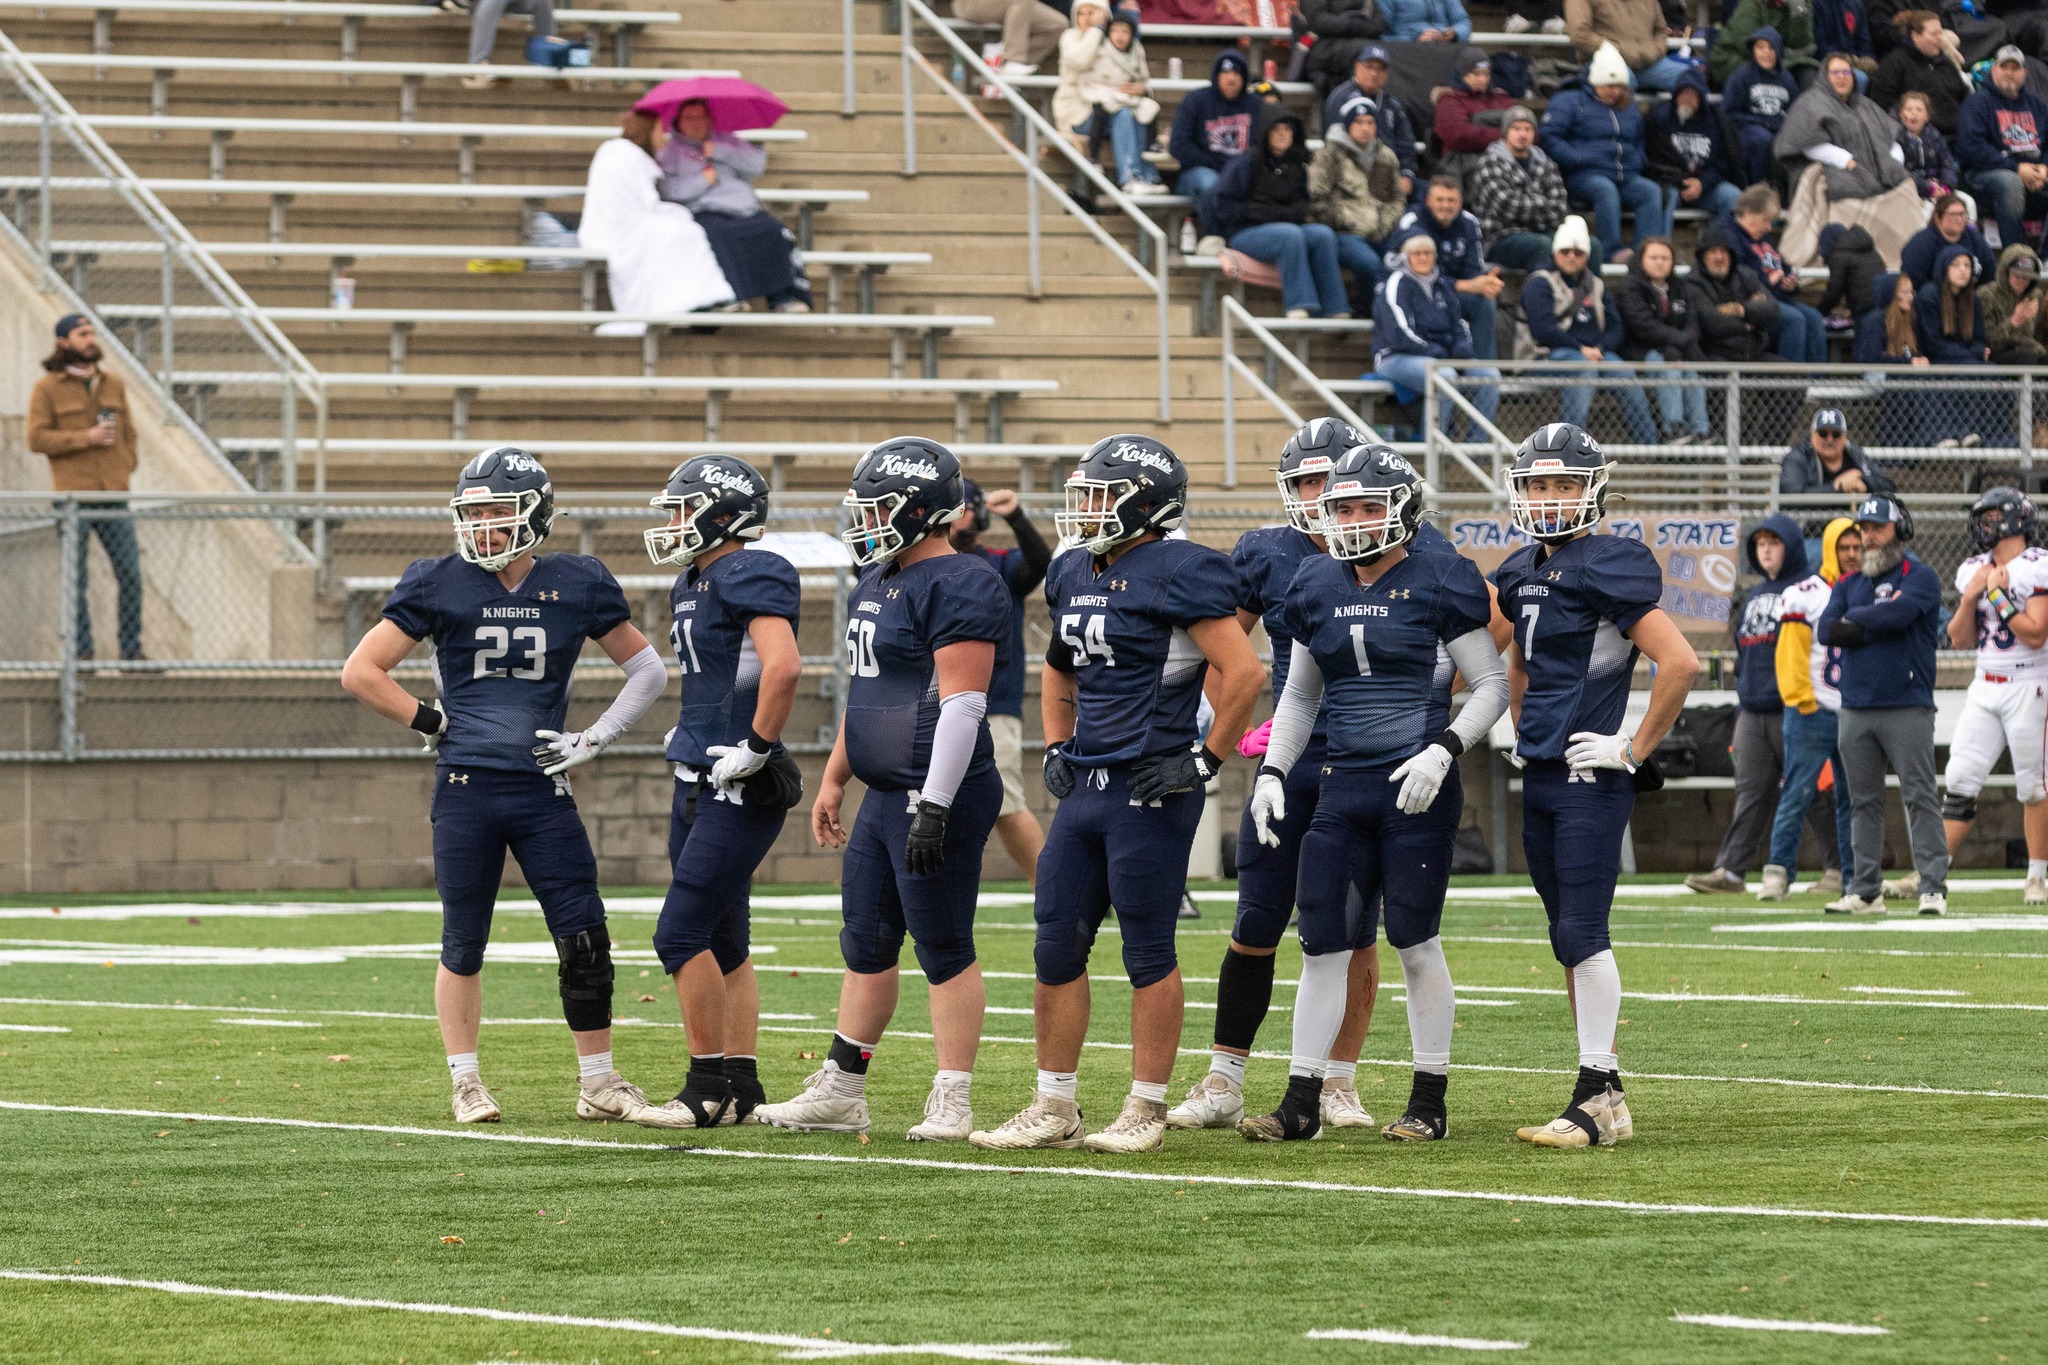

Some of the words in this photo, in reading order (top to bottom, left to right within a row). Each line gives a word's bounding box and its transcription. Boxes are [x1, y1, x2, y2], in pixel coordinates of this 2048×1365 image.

[504, 454, 548, 474] Knig
[875, 454, 940, 481] Knights
[1111, 442, 1174, 475] Knights
[1302, 458, 1328, 466] Riddell
[1378, 451, 1419, 480] Knig
[699, 464, 755, 497] Knights
[1334, 482, 1358, 490] Riddell
[1864, 501, 1878, 515] N
[1656, 521, 1738, 547] STATE
[1668, 551, 1698, 582] GO
[1070, 594, 1108, 607] KNIGHTS
[1518, 584, 1549, 597] KNIGHTS
[482, 607, 541, 619] KNIGHTS
[1333, 604, 1389, 618] KNIGHTS
[1059, 613, 1116, 668] 54
[1522, 604, 1540, 661] 7
[472, 625, 548, 681] 23
[669, 618, 701, 675] 21
[844, 617, 880, 678] 60
[1349, 623, 1372, 677] 1
[1194, 756, 1211, 777] NIKE
